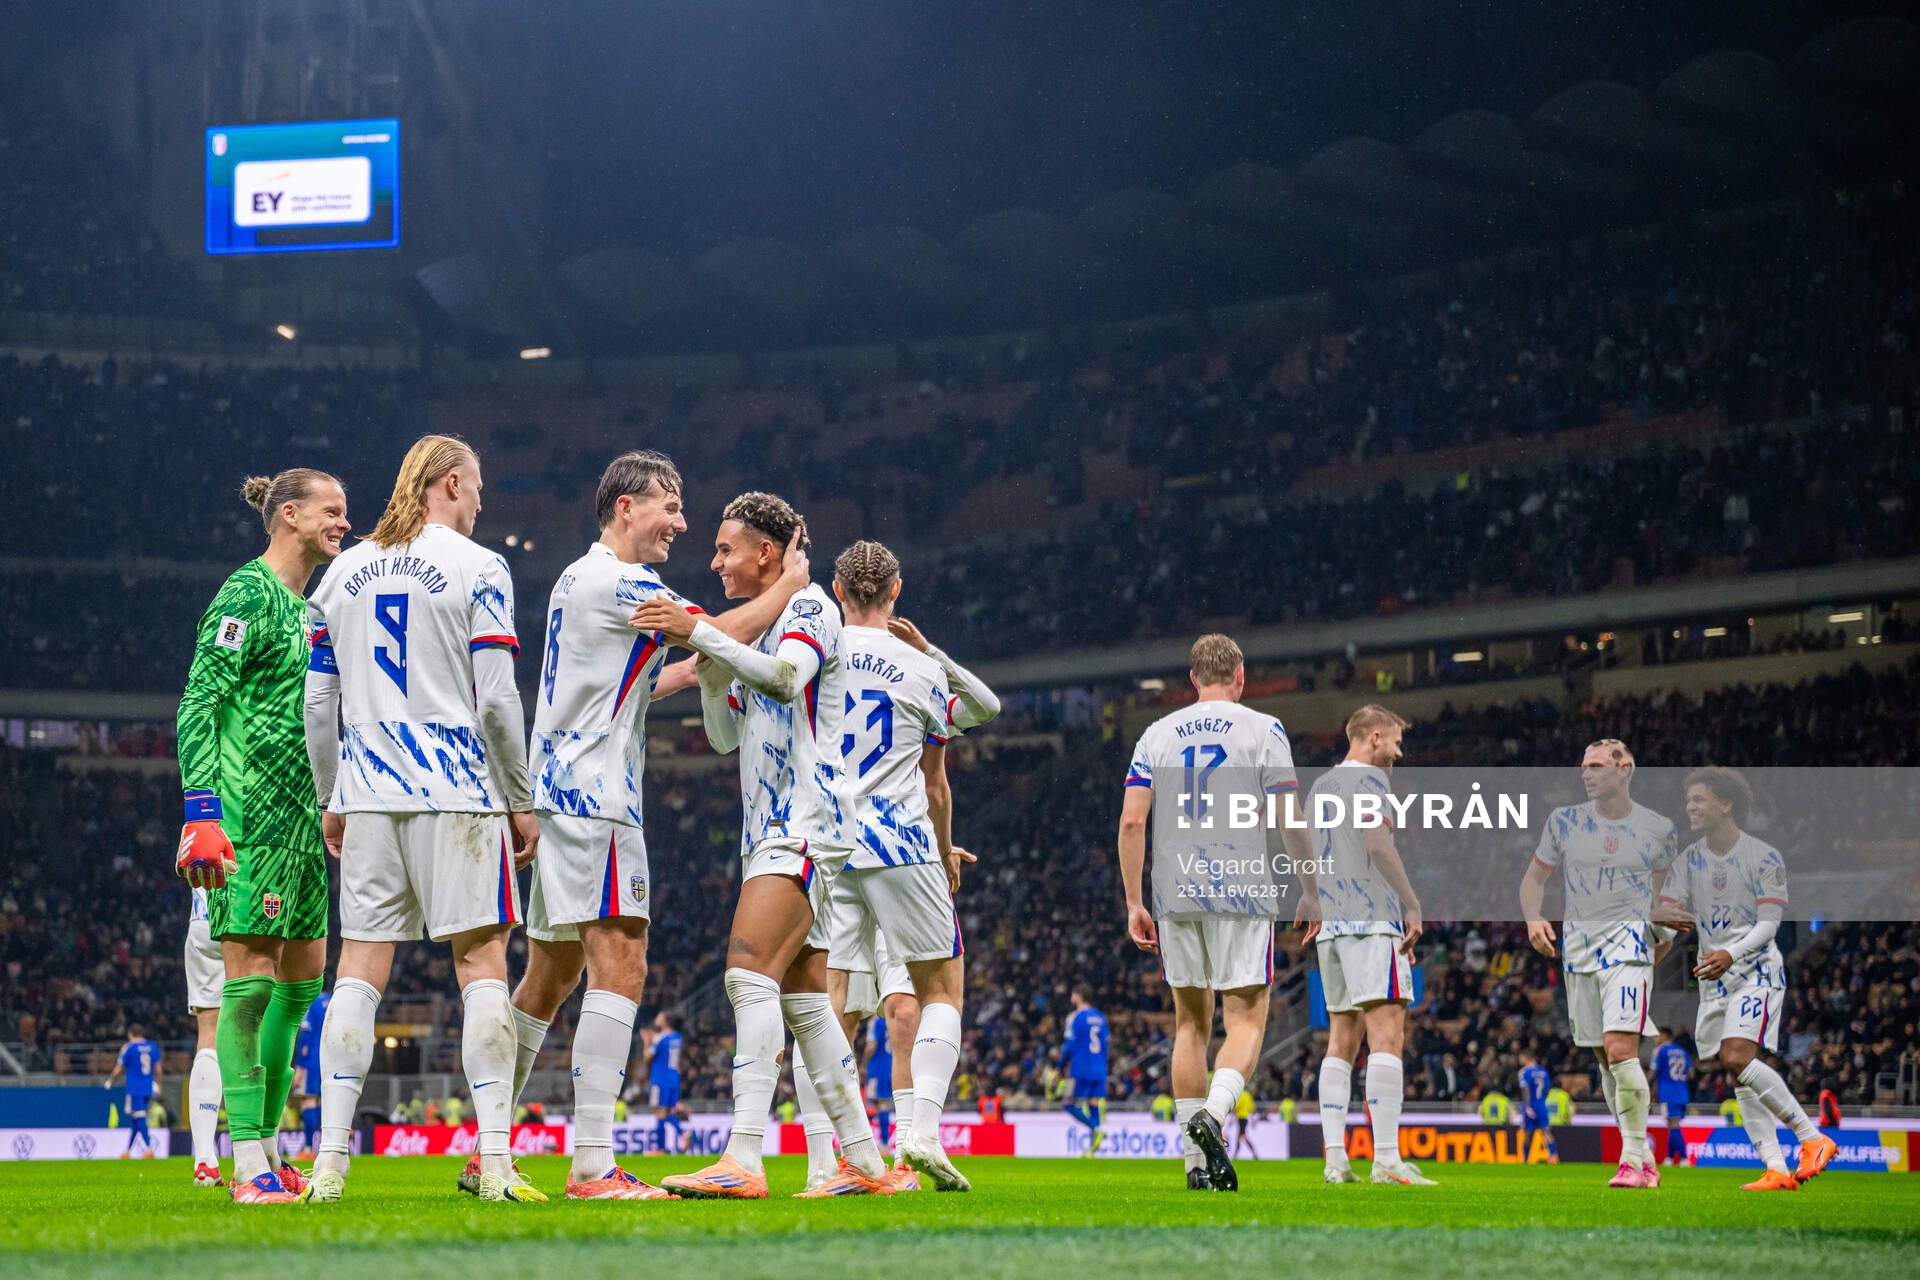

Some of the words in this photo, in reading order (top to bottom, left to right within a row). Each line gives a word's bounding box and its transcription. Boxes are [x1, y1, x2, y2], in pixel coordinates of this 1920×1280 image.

[252, 191, 284, 214] EY
[344, 558, 387, 597] BRAUT
[391, 557, 448, 594] HAALAND
[374, 593, 409, 699] 9
[544, 607, 563, 707] 8
[1175, 717, 1234, 739] HEGGEM
[1180, 743, 1228, 821] 17
[1597, 867, 1616, 892] 14
[1711, 905, 1732, 930] 22
[1621, 985, 1637, 1012] 14
[1741, 996, 1762, 1020] 22
[1089, 1025, 1101, 1054] 5
[1668, 1056, 1687, 1082] 22
[1686, 1142, 1714, 1159] FIFA
